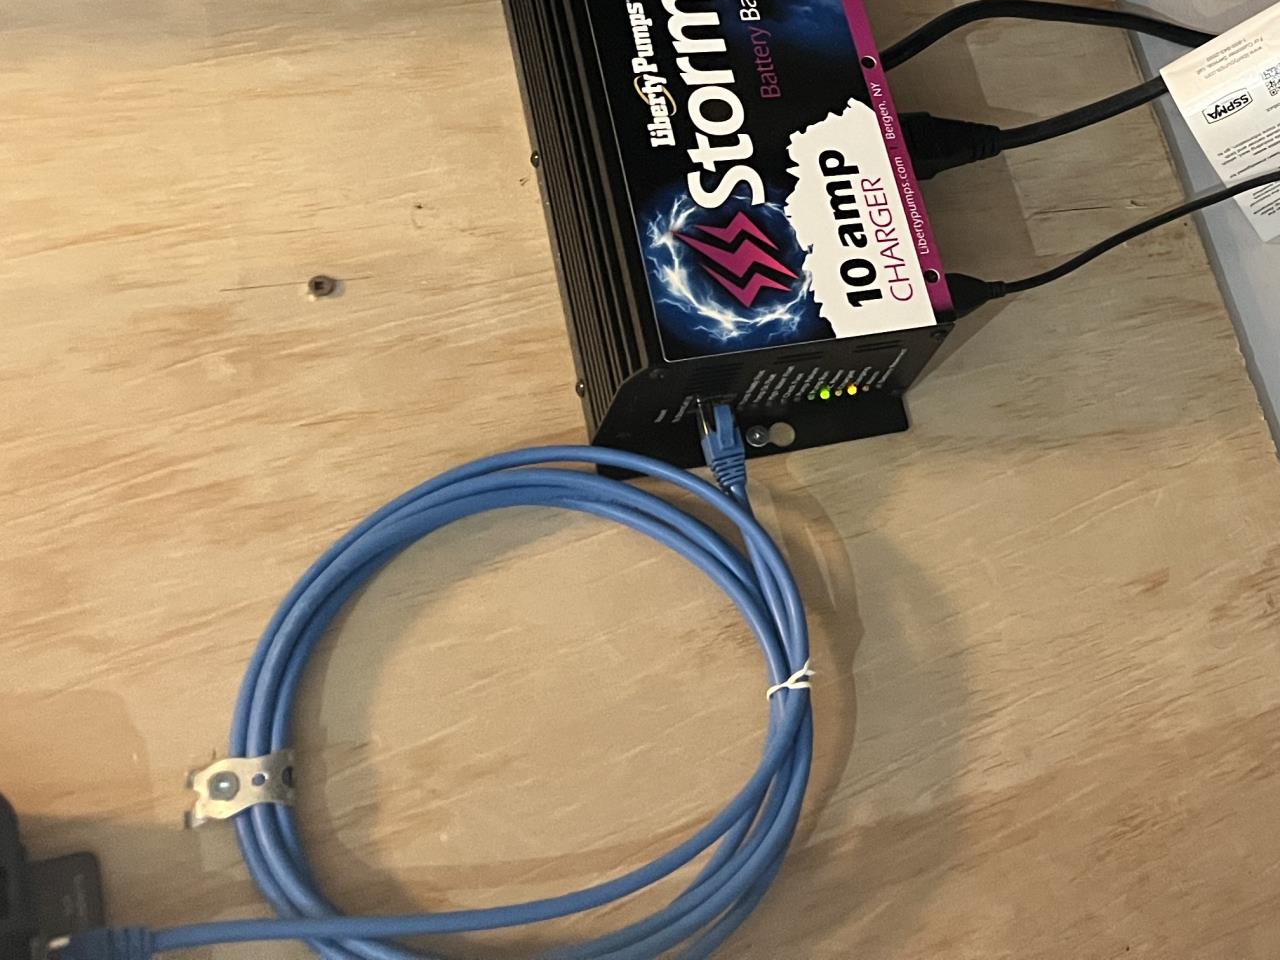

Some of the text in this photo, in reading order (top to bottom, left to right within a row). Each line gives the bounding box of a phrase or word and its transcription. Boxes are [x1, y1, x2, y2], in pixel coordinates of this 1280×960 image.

[626, 1, 676, 147] Liberty Pumps
[747, 26, 781, 98] Battery
[1207, 94, 1249, 119] SSPMA
[819, 150, 883, 307] 10 amp
[870, 82, 930, 254] Libertypumps.com Bergen, NY
[861, 178, 913, 301] CHARGER
